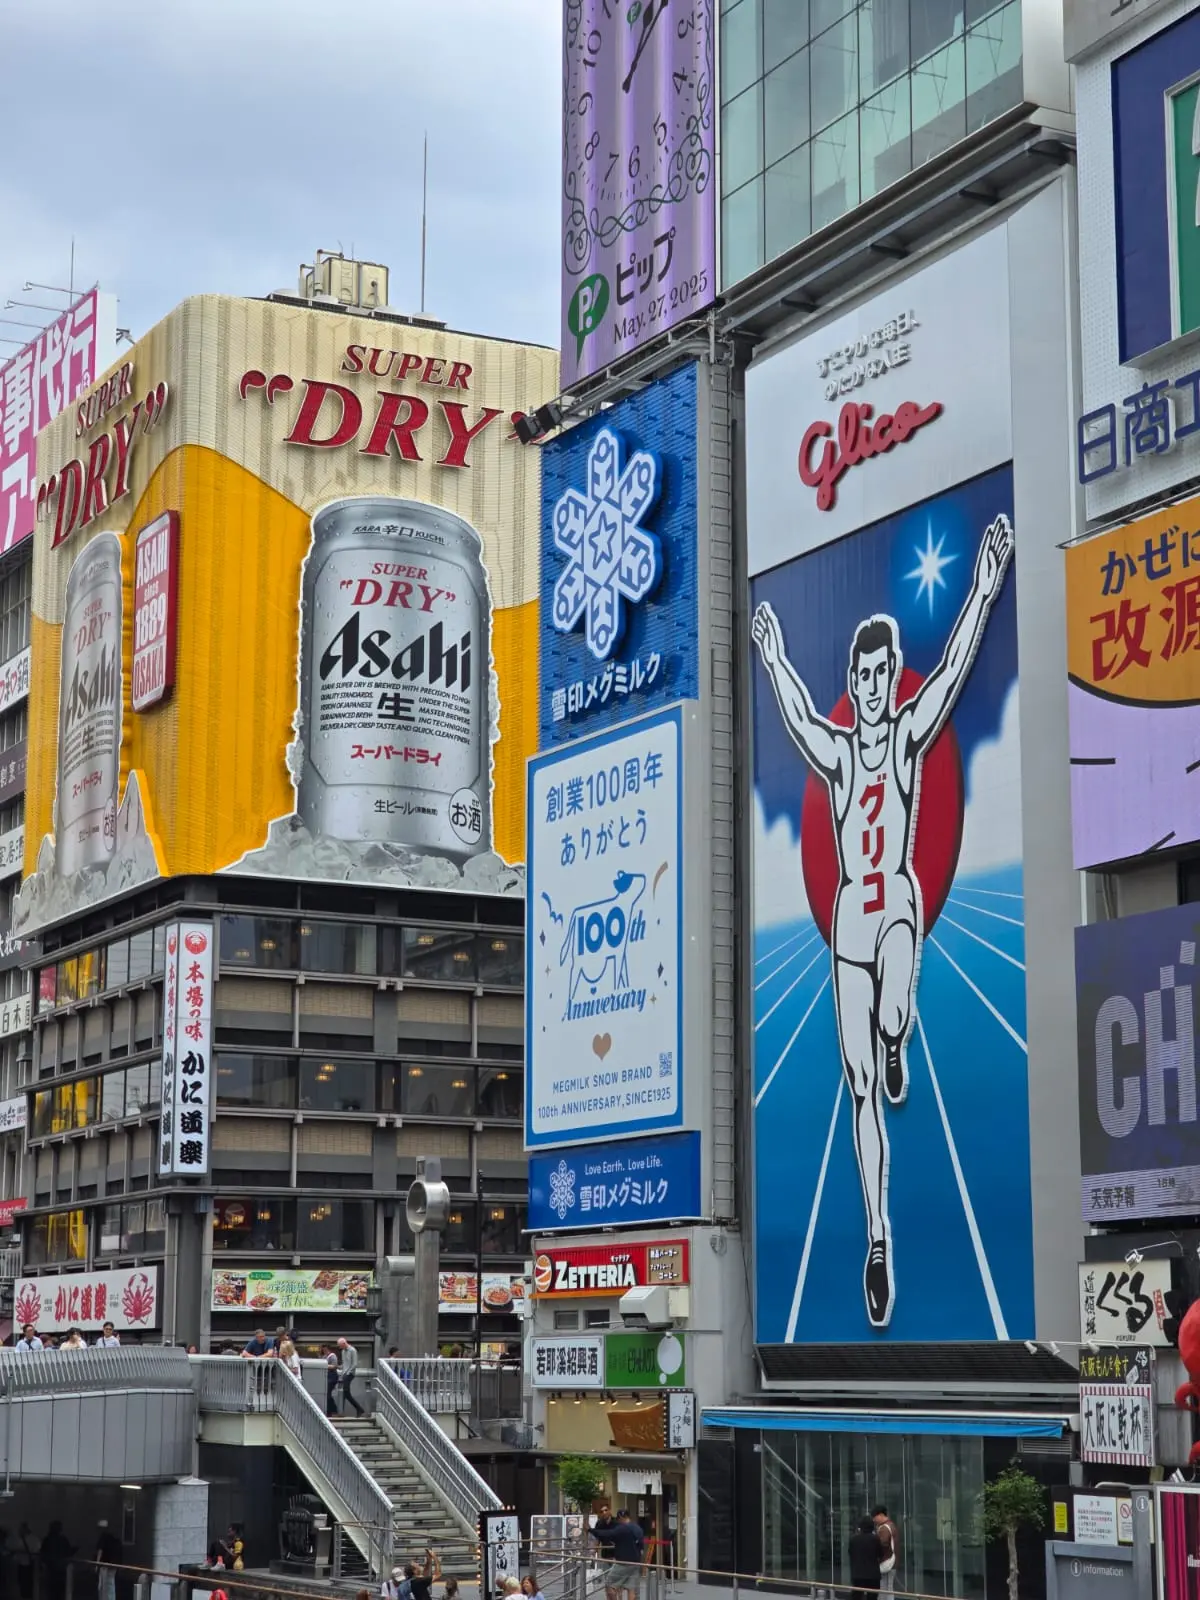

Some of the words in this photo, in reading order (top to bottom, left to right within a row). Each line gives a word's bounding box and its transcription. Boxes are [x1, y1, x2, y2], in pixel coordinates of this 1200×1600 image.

[615, 225, 676, 306] ピップ
[613, 312, 646, 345] May.
[649, 294, 668, 322] 27,
[671, 270, 708, 310] 2025
[0, 295, 94, 457] 事代行
[341, 344, 473, 390] SUPER
[75, 361, 135, 440] SUPER
[799, 401, 943, 511] Glico
[136, 529, 169, 589] ASAHI
[354, 525, 382, 534] KARA
[382, 524, 414, 537] 辛口
[415, 531, 445, 543] KUCHI
[371, 562, 428, 581] SUPER
[134, 645, 164, 700] OSAKA
[319, 611, 471, 692] Asahi
[65, 642, 116, 733] Asahi
[377, 693, 415, 722] 生
[551, 651, 661, 723] 雪印メグミルク
[351, 745, 442, 767] スーパードライ
[374, 799, 414, 816] 生ビール
[546, 751, 664, 823] 創業100周年
[451, 802, 481, 833] お酒
[560, 808, 647, 867] ありがとう
[858, 772, 887, 915] グリコ
[577, 905, 646, 956] 100th
[185, 960, 205, 1042] 本場の味
[561, 988, 647, 1022] Anniversary
[552, 1076, 590, 1094] MEGMILK
[593, 1071, 619, 1087] SNOW
[621, 1065, 652, 1082] BRAND
[580, 1176, 668, 1211] 雪印メグミルク
[584, 1163, 602, 1175] Love
[628, 1159, 645, 1170] Love
[555, 1260, 636, 1290] ZETTERIA
